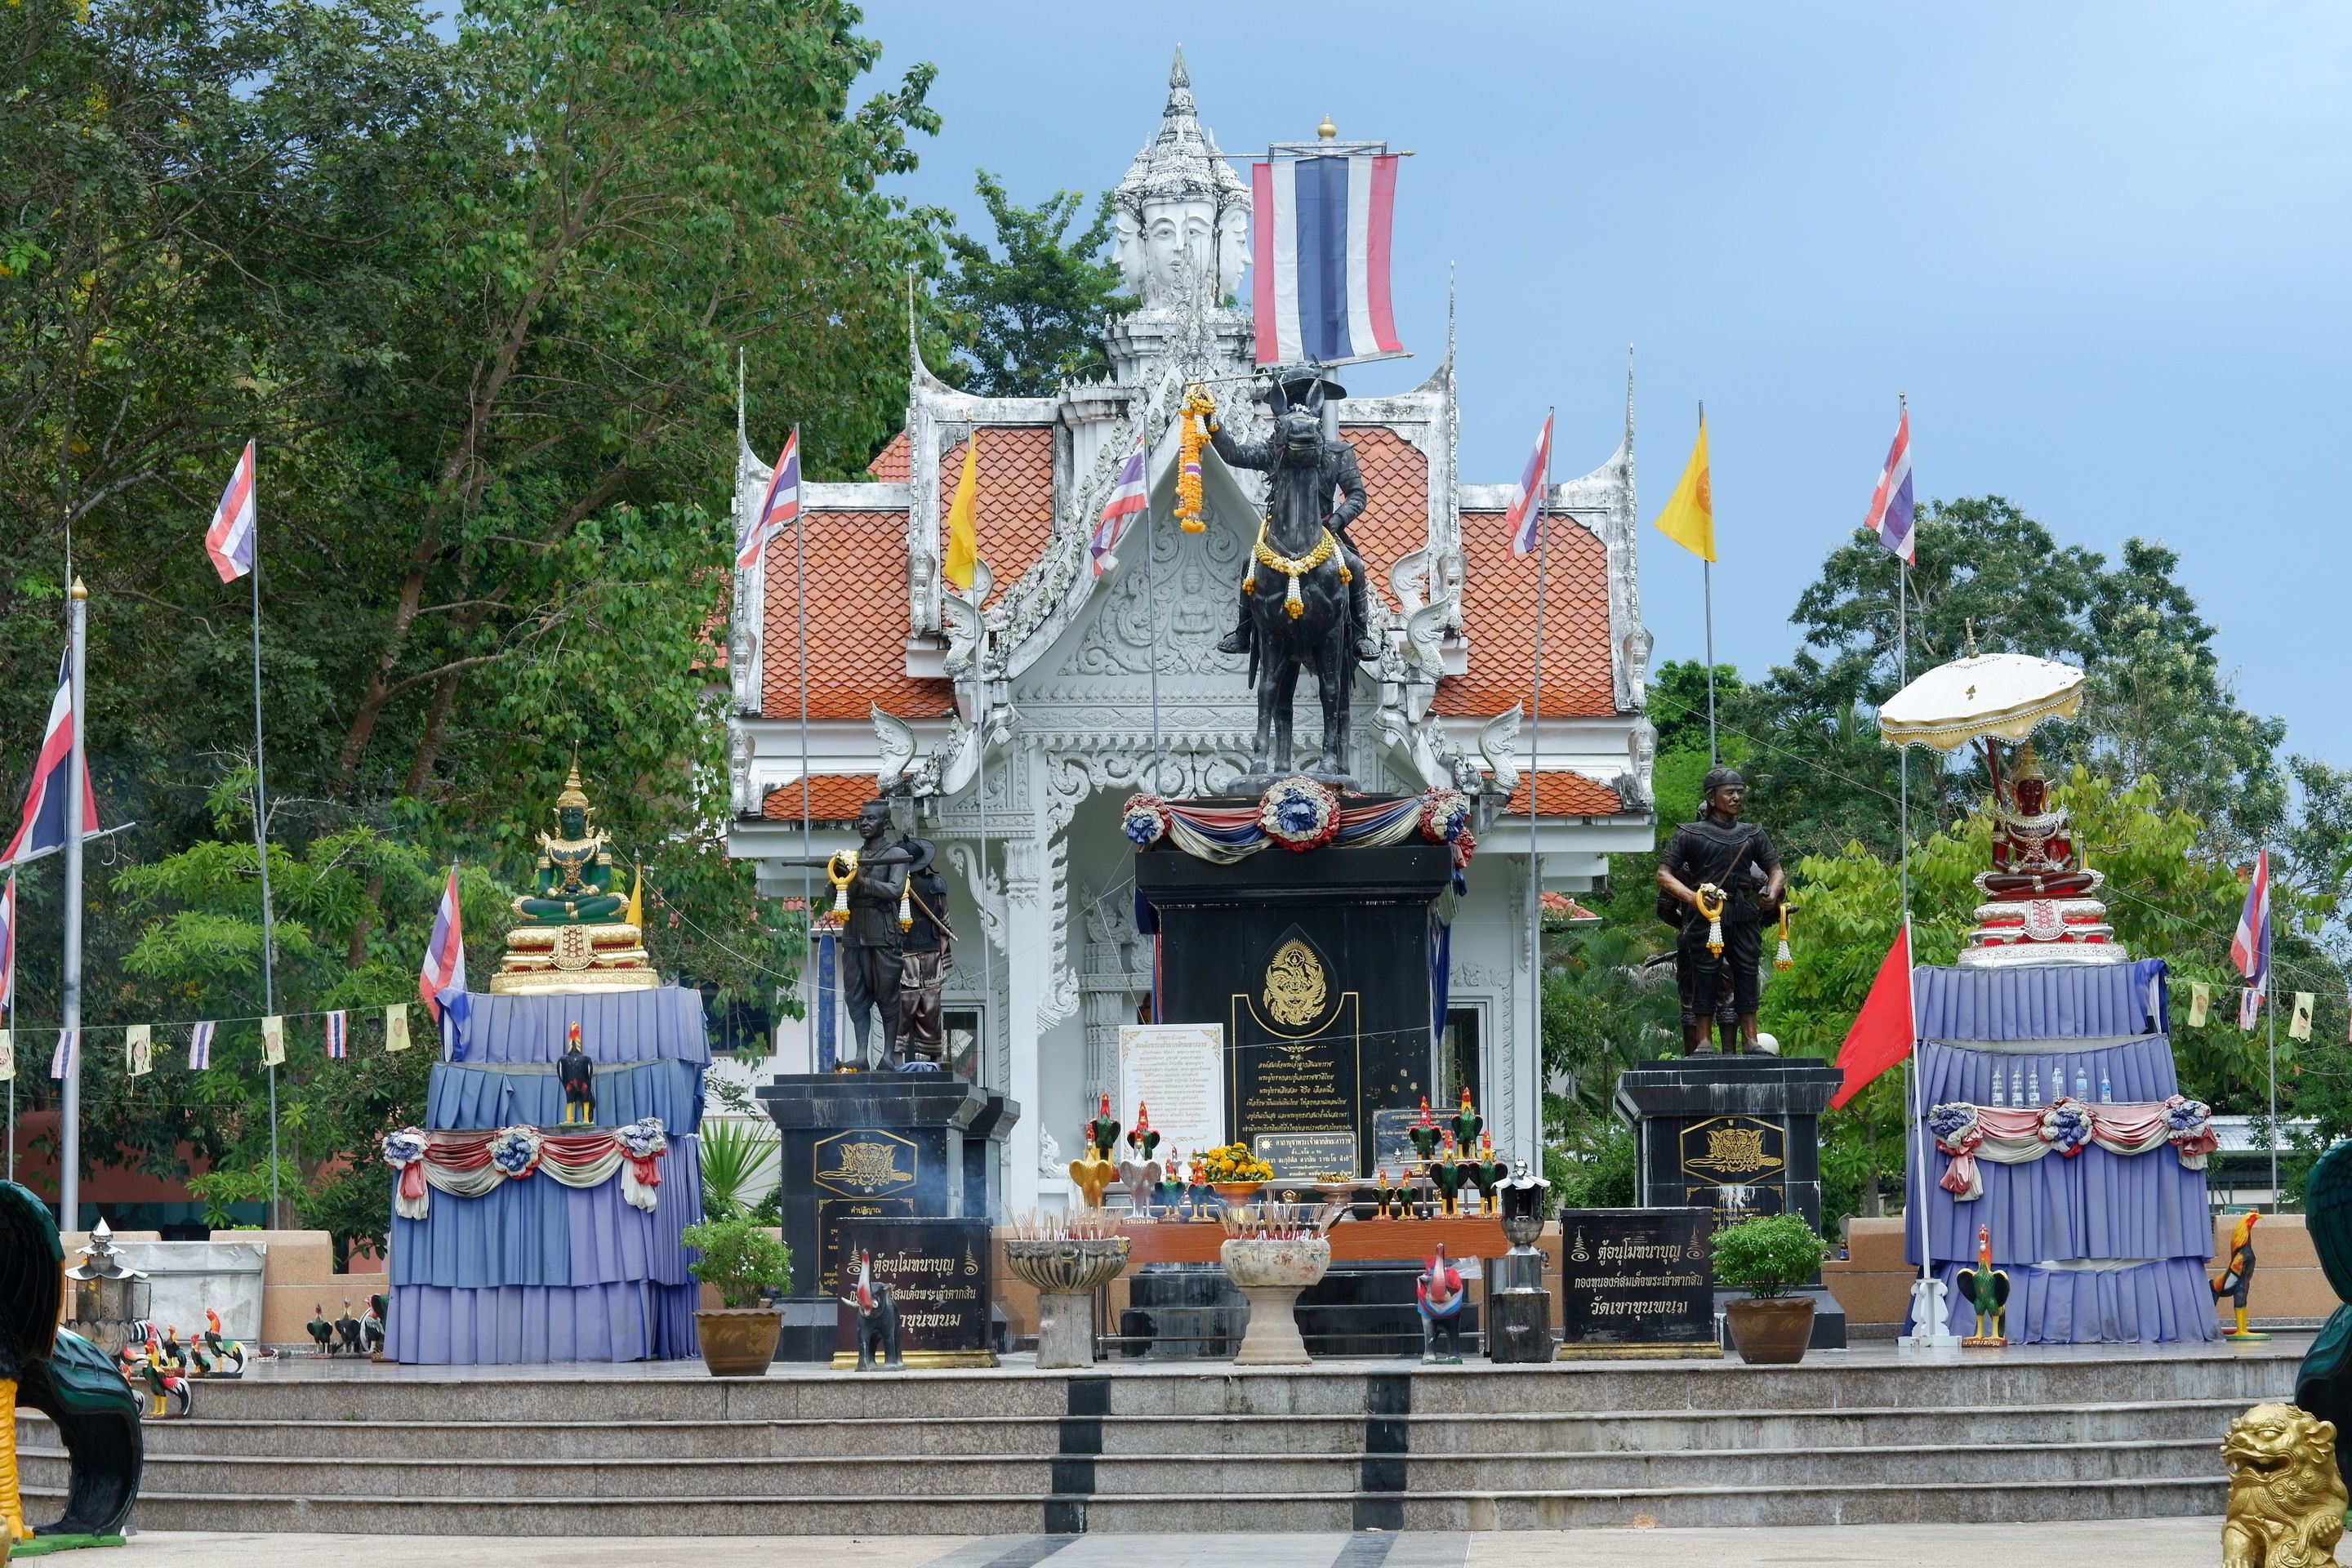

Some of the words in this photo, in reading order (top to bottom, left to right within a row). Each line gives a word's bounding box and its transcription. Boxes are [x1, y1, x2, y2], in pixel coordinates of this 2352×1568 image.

[1597, 1236, 1682, 1266] ตู้อนุโมทนาบุญ
[873, 1251, 955, 1279] ตู้อนุโมทนาบุญ
[1575, 1270, 1704, 1292] กองทุนองค์สมเด็จพระเจ้าตากสิน
[1590, 1295, 1688, 1321] วัดเขาขุนพนม
